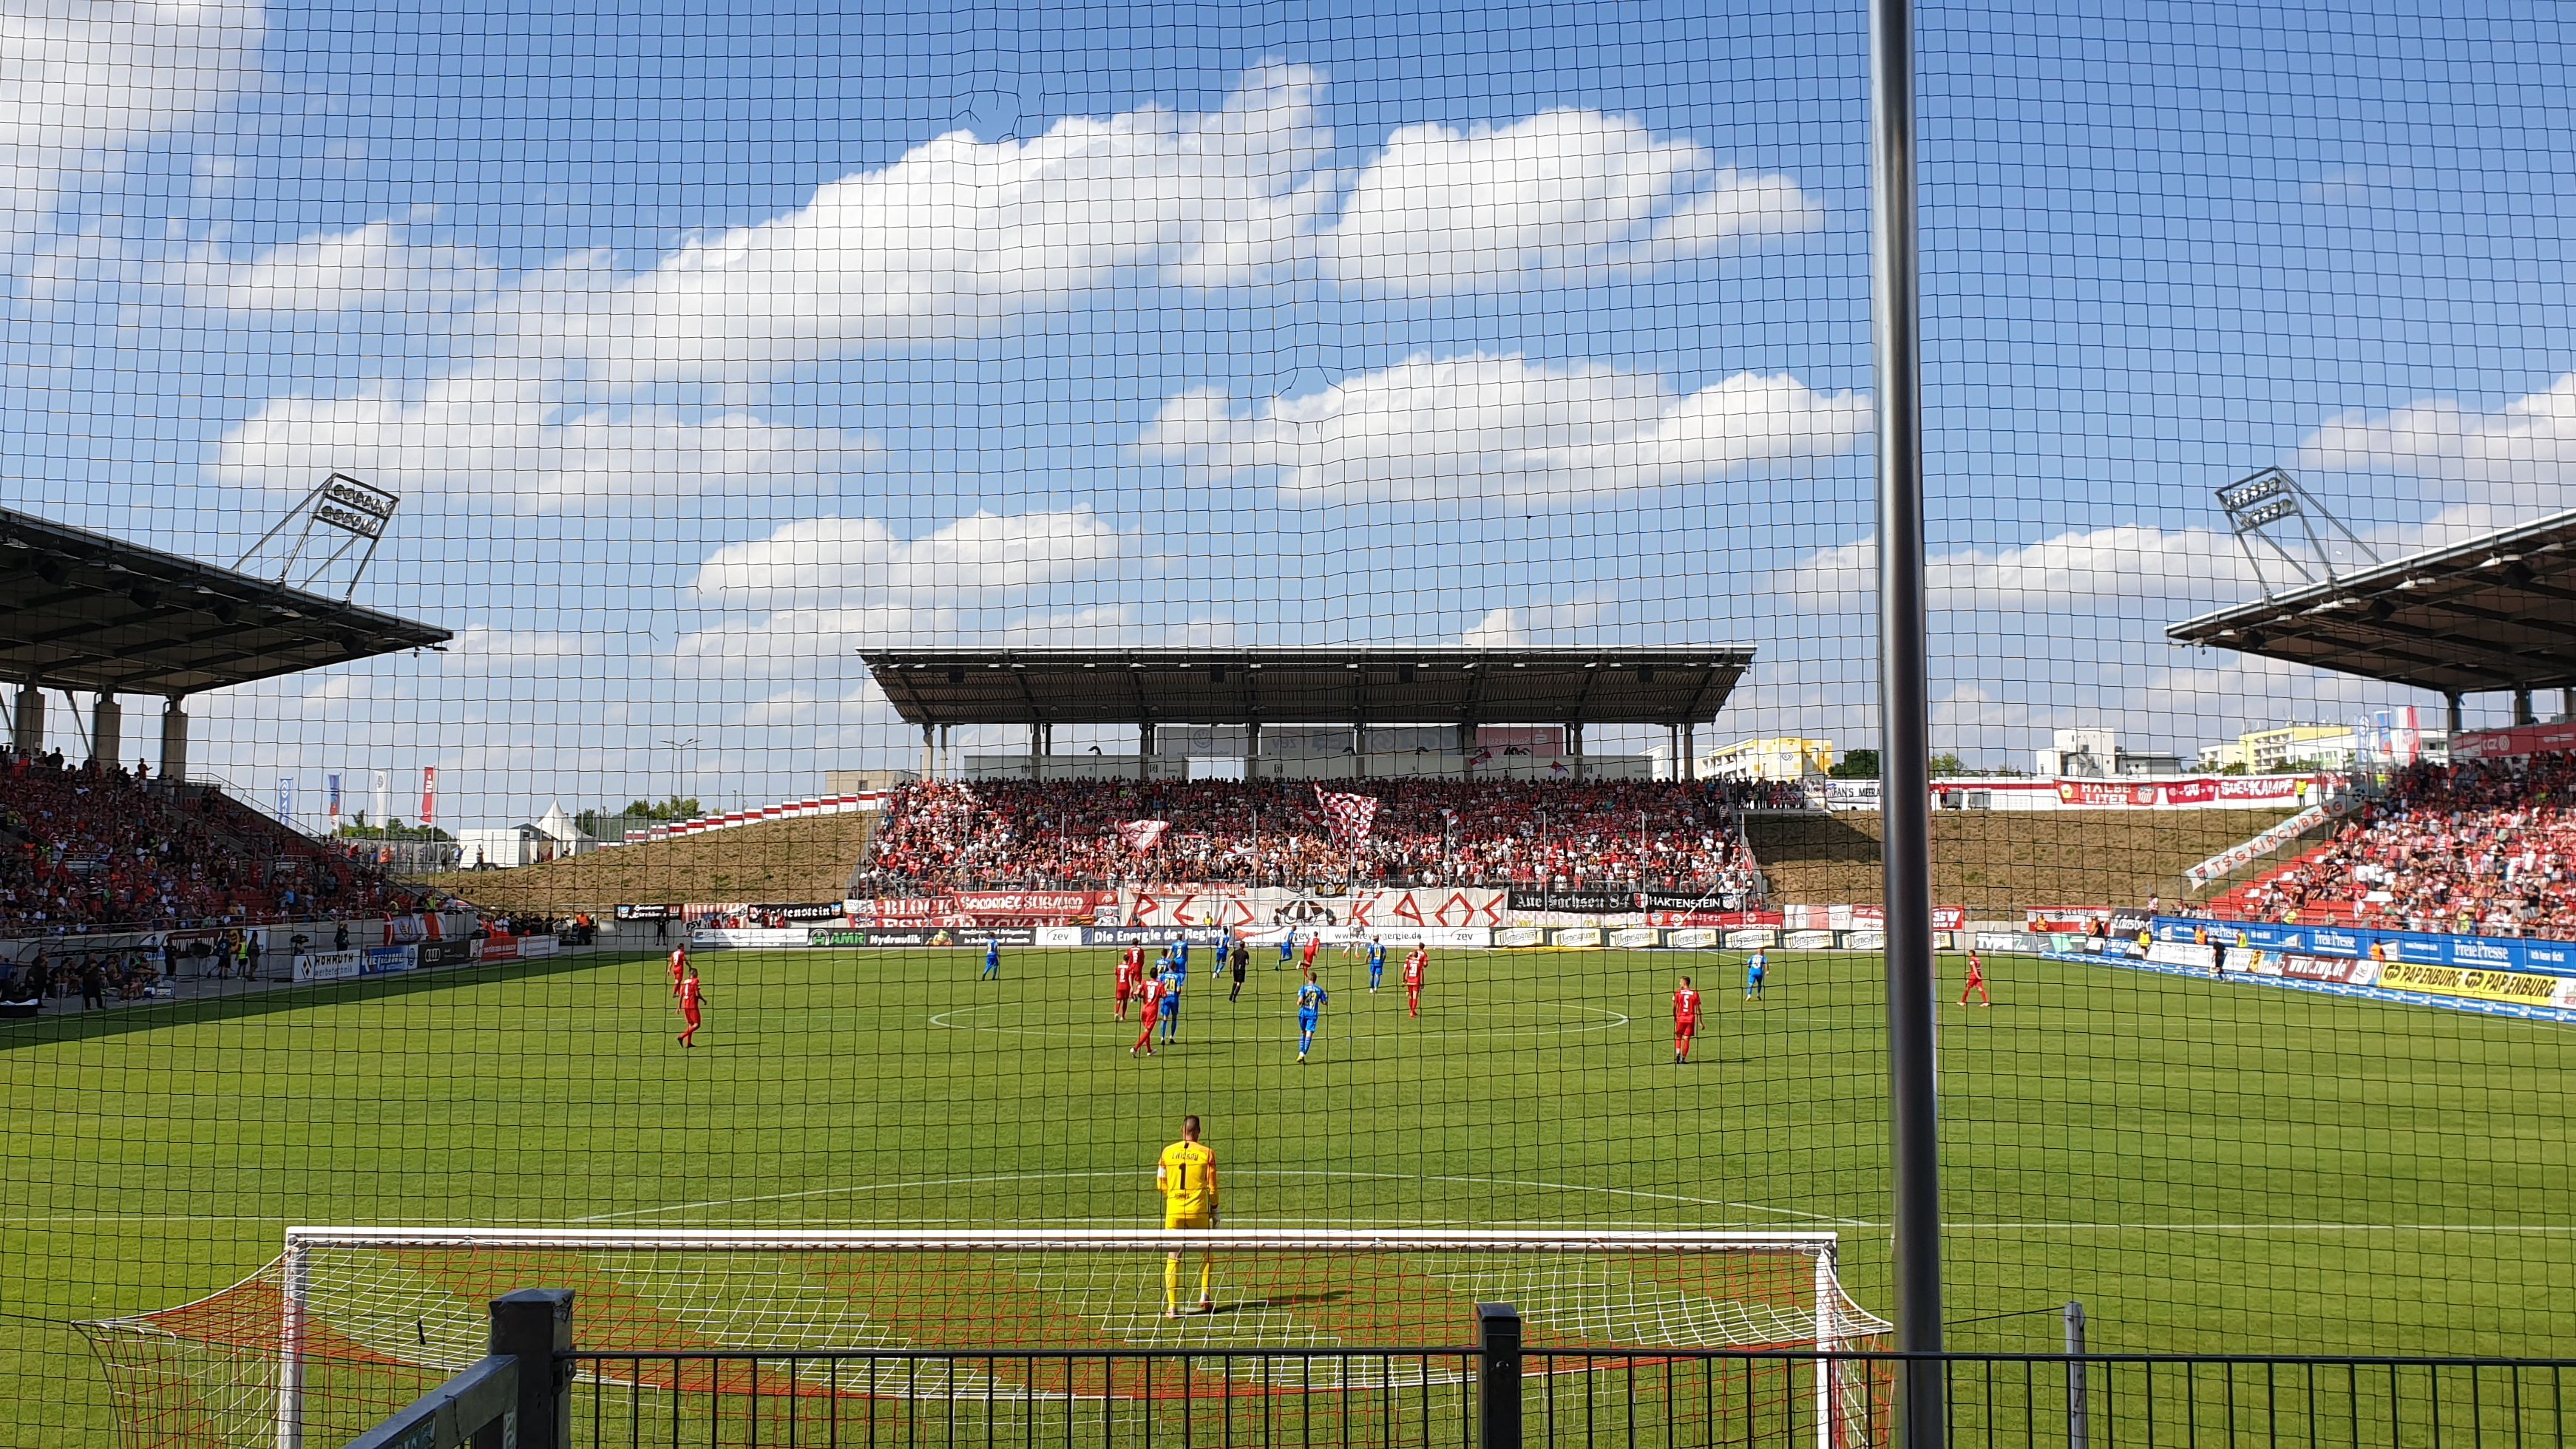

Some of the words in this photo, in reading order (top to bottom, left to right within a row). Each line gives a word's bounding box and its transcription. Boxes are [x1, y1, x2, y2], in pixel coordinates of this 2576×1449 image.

[2081, 783, 2132, 793] HALBE
[2085, 793, 2128, 804] LITER
[869, 898, 954, 915] A-BLOCK
[1933, 910, 1961, 923] SV
[829, 932, 865, 946] AMR
[870, 934, 921, 947] Hydraulik
[1052, 933, 1068, 941] zev
[1094, 930, 1114, 943] Die
[1116, 929, 1161, 946] Energie
[1163, 929, 1183, 943] der
[1457, 932, 1474, 941] zev
[2400, 966, 2464, 988] PAPENBURG
[2482, 972, 2558, 998] PAPENBURG
[1179, 1162, 1186, 1190] 1
